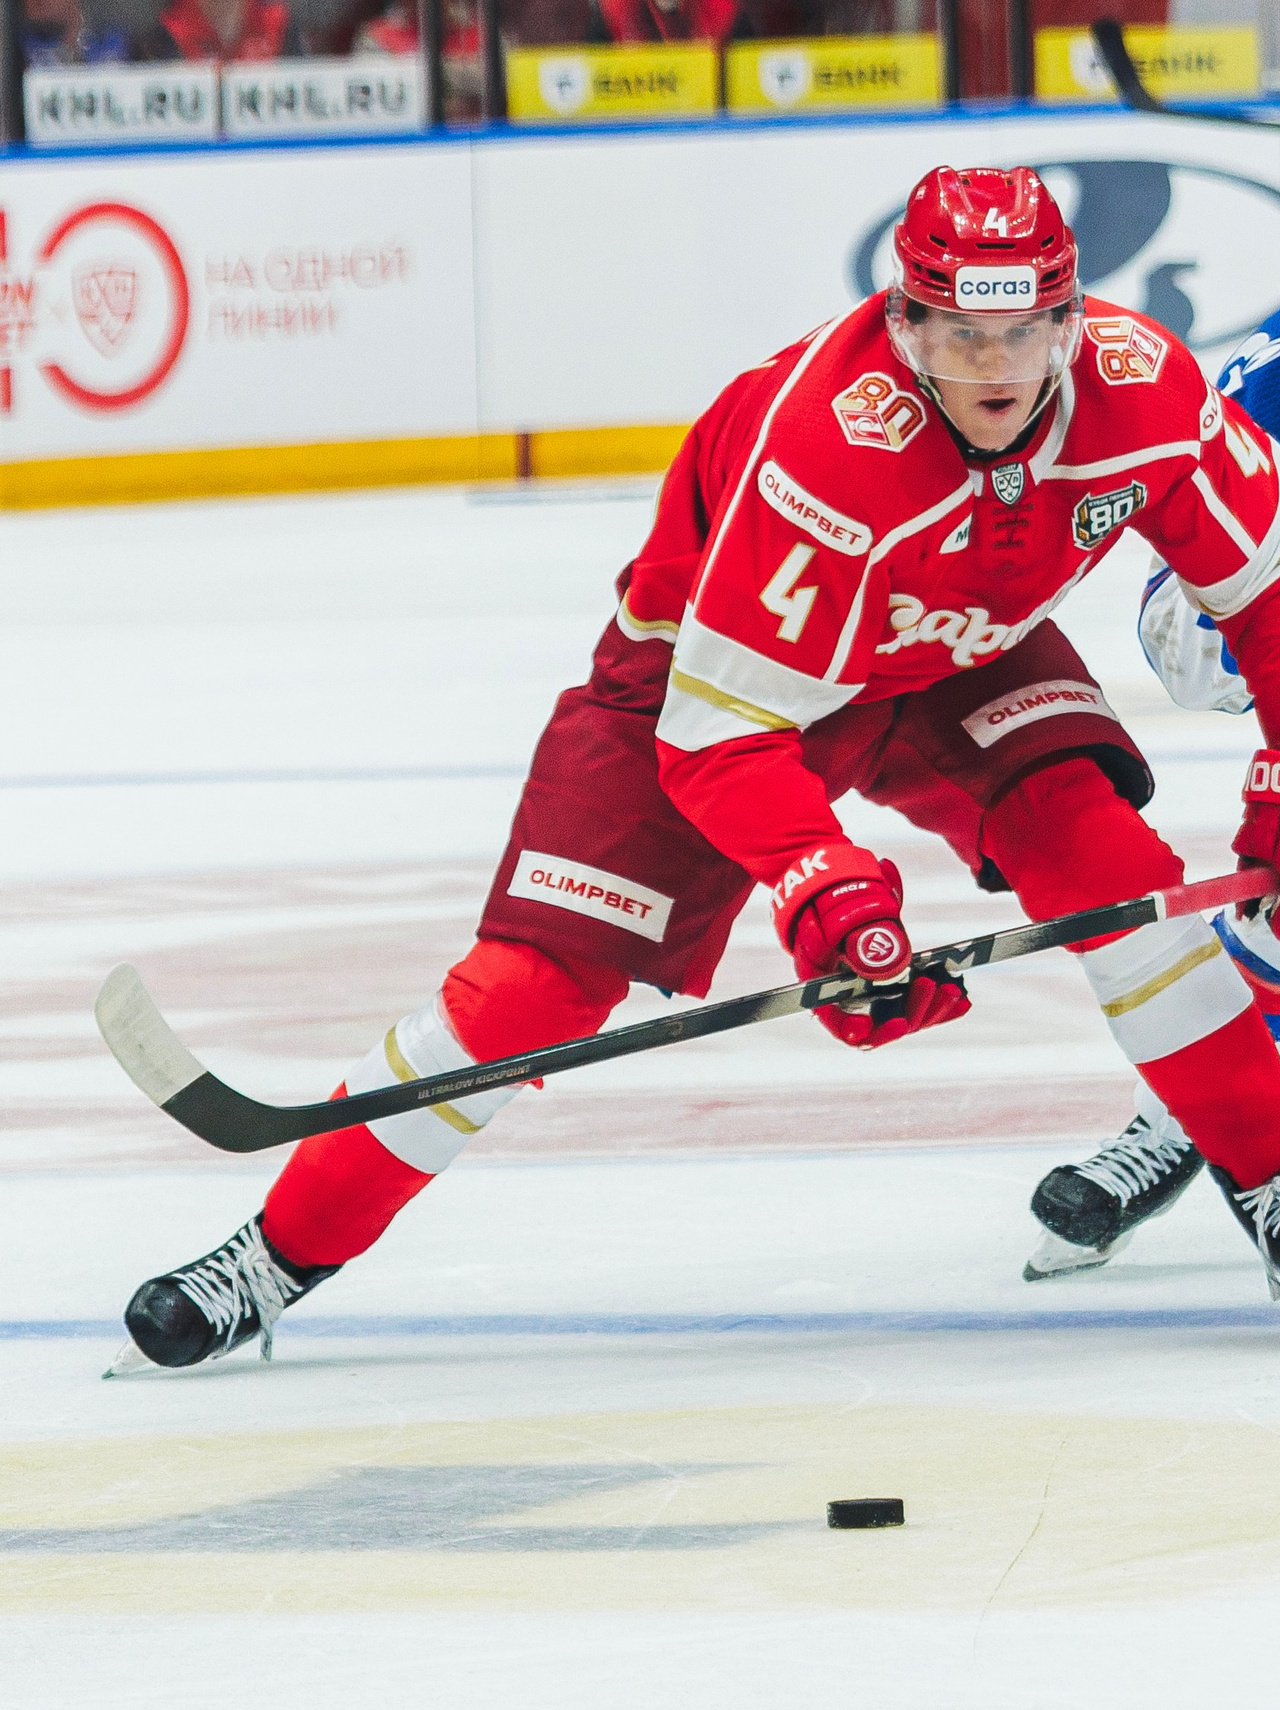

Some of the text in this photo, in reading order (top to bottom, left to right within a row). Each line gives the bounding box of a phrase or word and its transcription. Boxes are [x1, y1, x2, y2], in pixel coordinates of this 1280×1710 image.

[38, 84, 201, 126] KHL.RU
[236, 78, 407, 122] KHL.RU
[984, 207, 1008, 237] 4
[960, 277, 1031, 297] согаз
[764, 473, 863, 546] OLIMPBET
[1089, 496, 1134, 535] 80
[759, 542, 819, 644] 4
[986, 690, 1099, 727] OLIMPBET
[529, 869, 654, 919] OLIMPBET
[771, 849, 829, 910] ТАК
